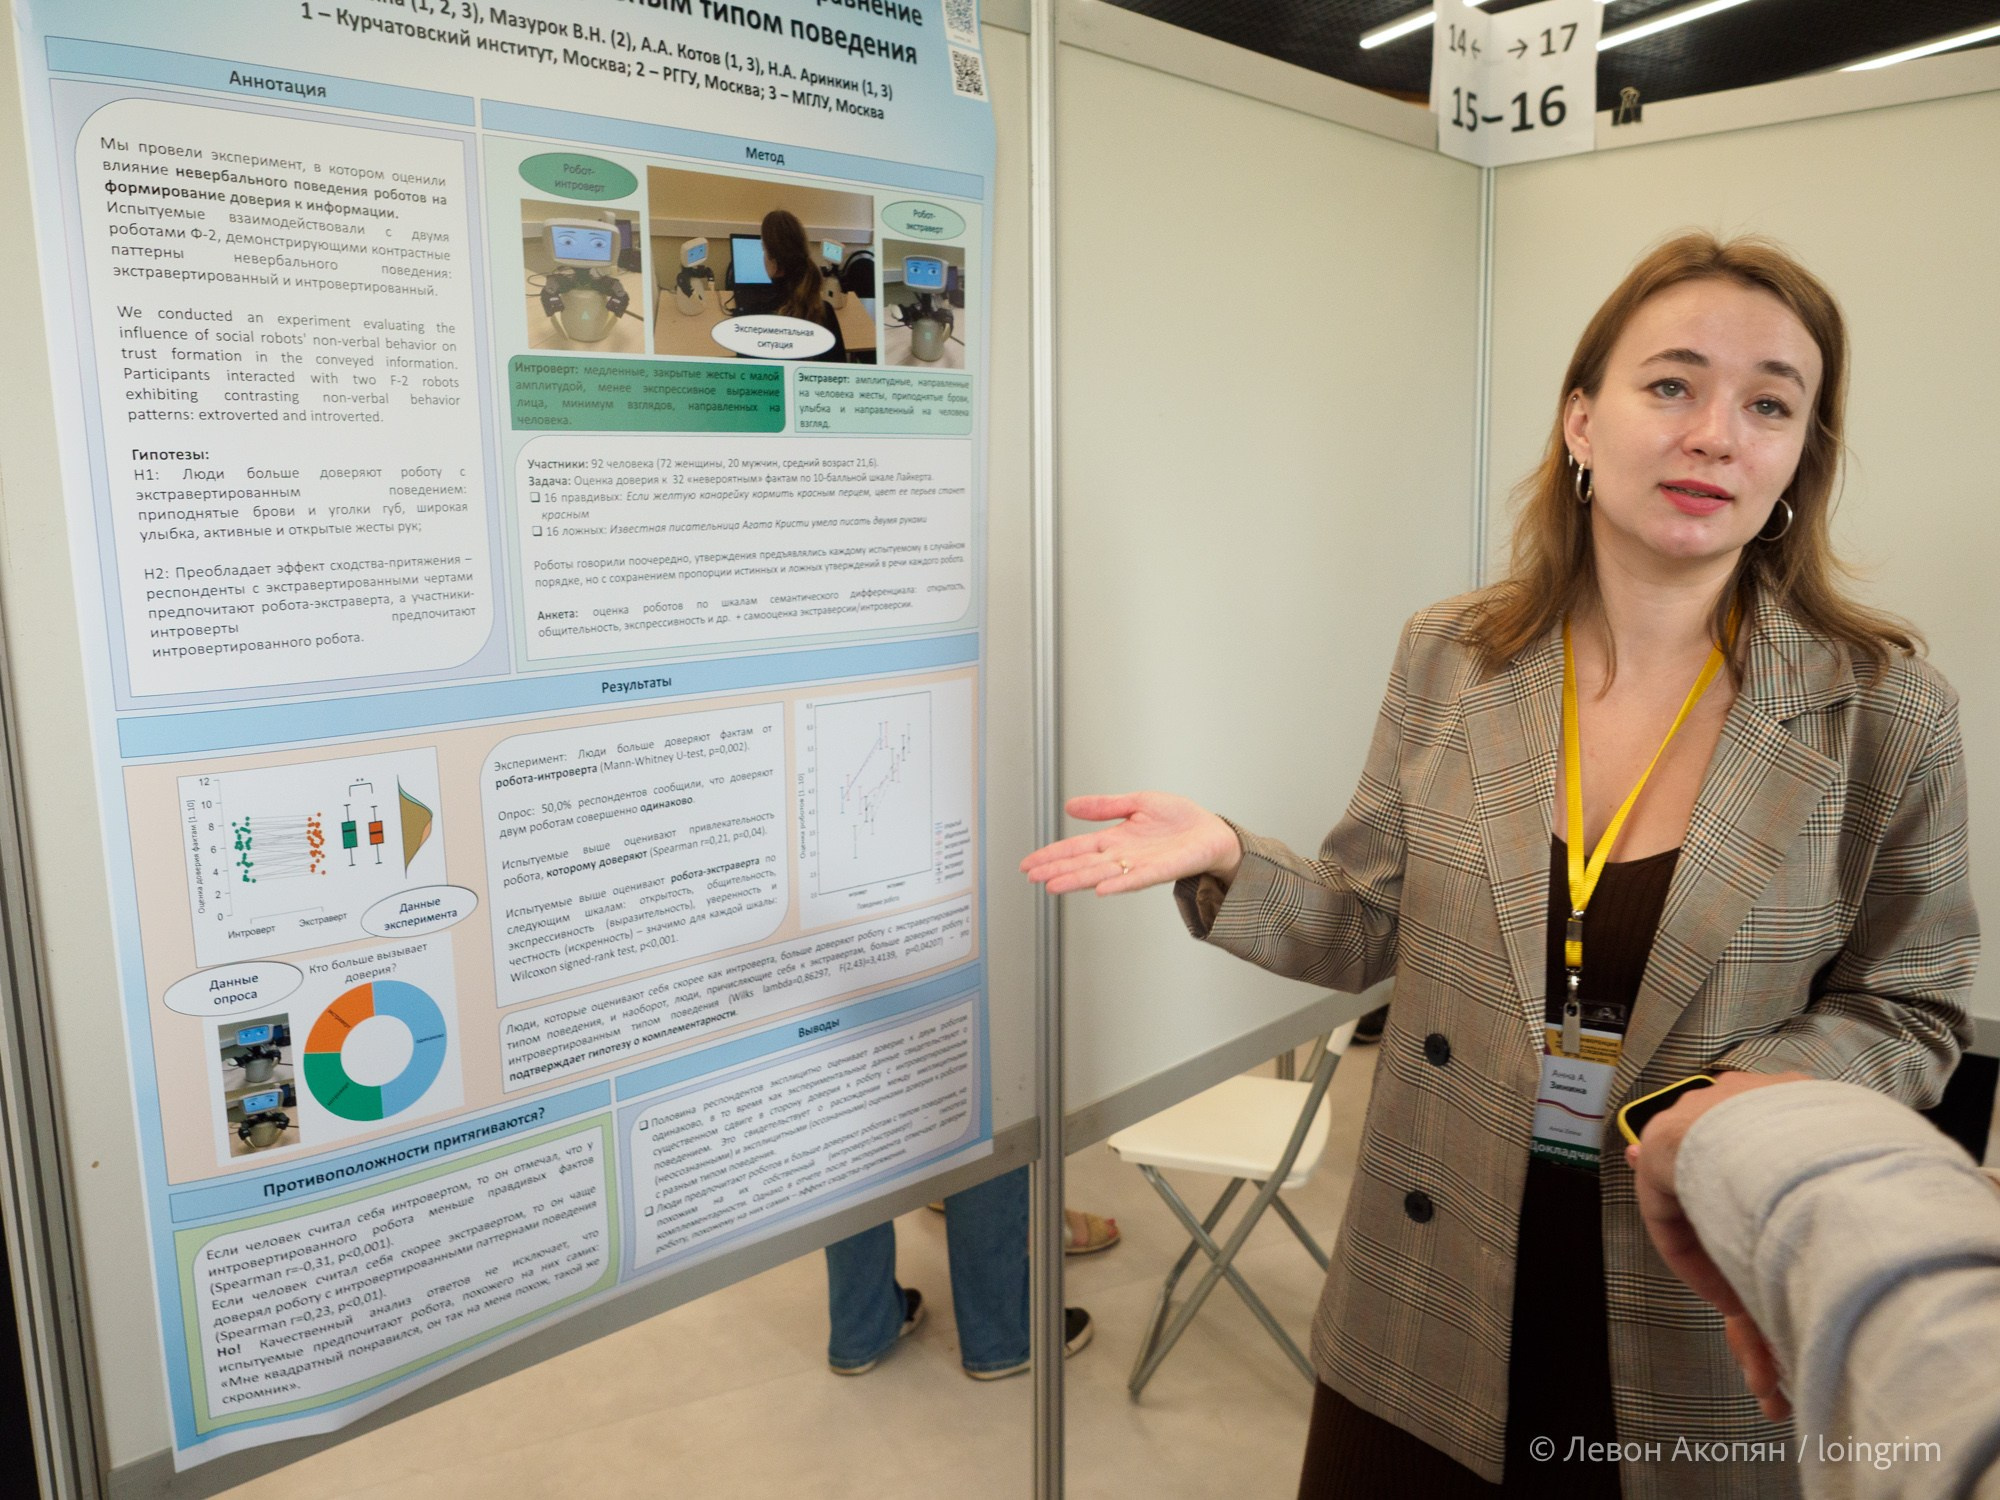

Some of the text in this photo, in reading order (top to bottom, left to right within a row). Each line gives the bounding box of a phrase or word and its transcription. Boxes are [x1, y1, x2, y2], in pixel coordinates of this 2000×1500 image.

[816, 0, 922, 26] внение
[699, 0, 917, 64] типом поведения
[1449, 24, 1466, 56] 14
[1540, 22, 1578, 57] 17
[411, 0, 892, 101] (1, 2, 3), Мазурок В.Н. (2), А.А. Котов (1, 3), Н.А. Аринкин (1, 3)
[301, 2, 884, 120] 1 Курчатовский институт, Москва; 2 РГГУ, Москва; 3 МГЛУ, Москва
[229, 70, 326, 98] Аннотация
[100, 136, 446, 186] Мы провели эксперимент, в котором оценили
[745, 146, 785, 165] Метод
[102, 160, 447, 205] влияние невербального поведения роботов на
[554, 179, 606, 194] интроверт
[104, 180, 398, 219] формирование доверия к информации.
[116, 305, 455, 334] We conducted an experiment evaluating the
[734, 323, 814, 336] Экспериментальная
[119, 325, 456, 351] influence of social robots' non-verbal behavior on
[757, 340, 793, 350] ситуация
[120, 347, 458, 369] trust formation in the conveyed information.
[132, 448, 209, 460] Гипотезы:
[527, 457, 879, 470] Участники: 92 человека (72 женщины, 20 мужчин, средний возраст 21,6).
[182, 468, 224, 481] Люди
[246, 466, 299, 479] больше
[319, 468, 382, 480] доверяют
[400, 465, 442, 479] роботу
[459, 468, 466, 476] с
[136, 485, 466, 502] экстравертированным поведением:
[601, 677, 671, 693] Результаты
[493, 725, 772, 772] Эксперимент: Люди больше доверяют фактам от
[495, 741, 749, 790] робота-интроверта (Mann-Whitney U-test, p=0,002).
[199, 776, 210, 786] 12
[201, 799, 212, 809] 10
[208, 822, 214, 831] 8
[210, 845, 216, 854] 6
[212, 868, 218, 876] 4
[215, 890, 221, 899] 2
[217, 912, 223, 921] 0
[399, 898, 440, 915] Данные
[298, 912, 347, 927] Экстраверт
[384, 910, 457, 931] эксперимента
[227, 925, 275, 939] Интроверт
[309, 943, 427, 974] Кто больше вызывает
[344, 962, 396, 984] доверия?
[208, 975, 258, 992] Данные
[213, 990, 257, 1005] опроса
[798, 1018, 839, 1038] Выводы
[509, 1009, 737, 1081] подтверждает гипотезу о комплементарности.
[263, 1106, 545, 1197] Противоположности притягиваются?
[206, 1141, 593, 1260] Если человек считал себя интровертом, то он отмечал, что у
[210, 1270, 282, 1295] (Spearman
